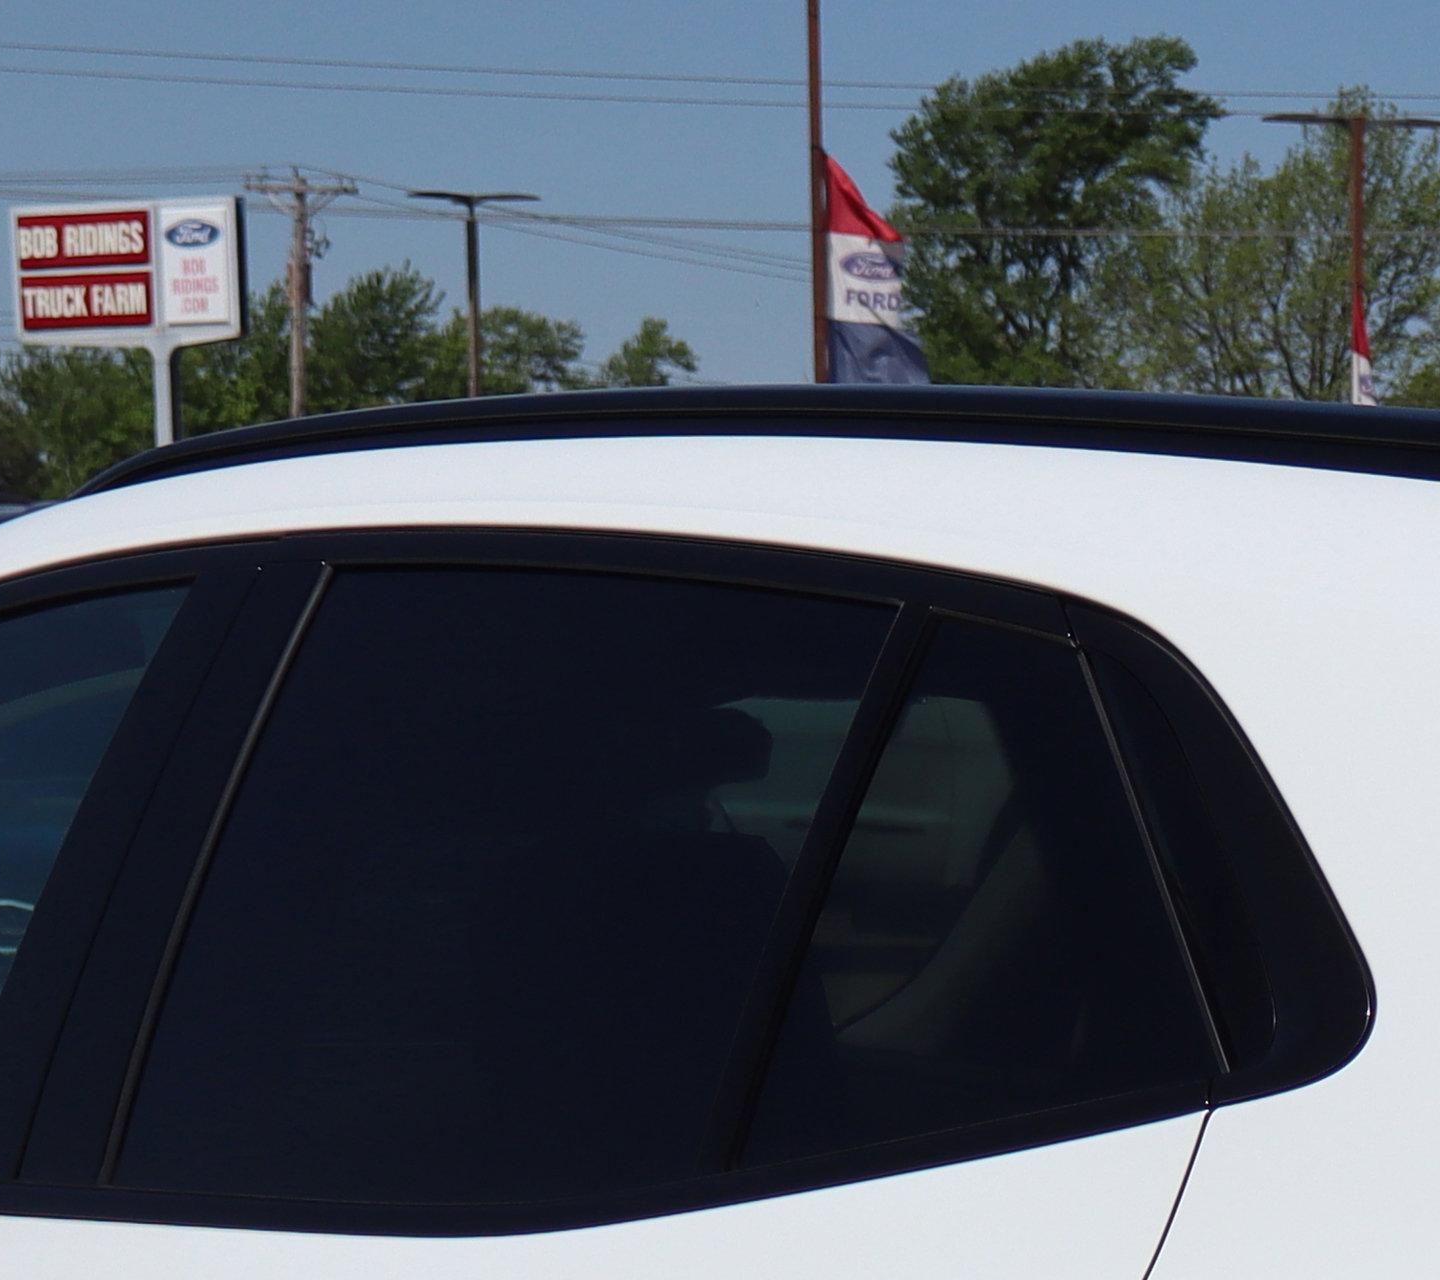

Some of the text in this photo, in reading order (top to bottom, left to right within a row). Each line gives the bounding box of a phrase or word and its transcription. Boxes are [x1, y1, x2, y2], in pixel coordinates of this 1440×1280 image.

[19, 220, 145, 260] BOB RIDINGS
[175, 223, 212, 244] Ford
[182, 258, 208, 275] BOB
[171, 277, 220, 295] RIDINGS
[23, 282, 147, 319] TRUCK FARM
[181, 296, 209, 313] .COM
[846, 290, 901, 311] FORD
